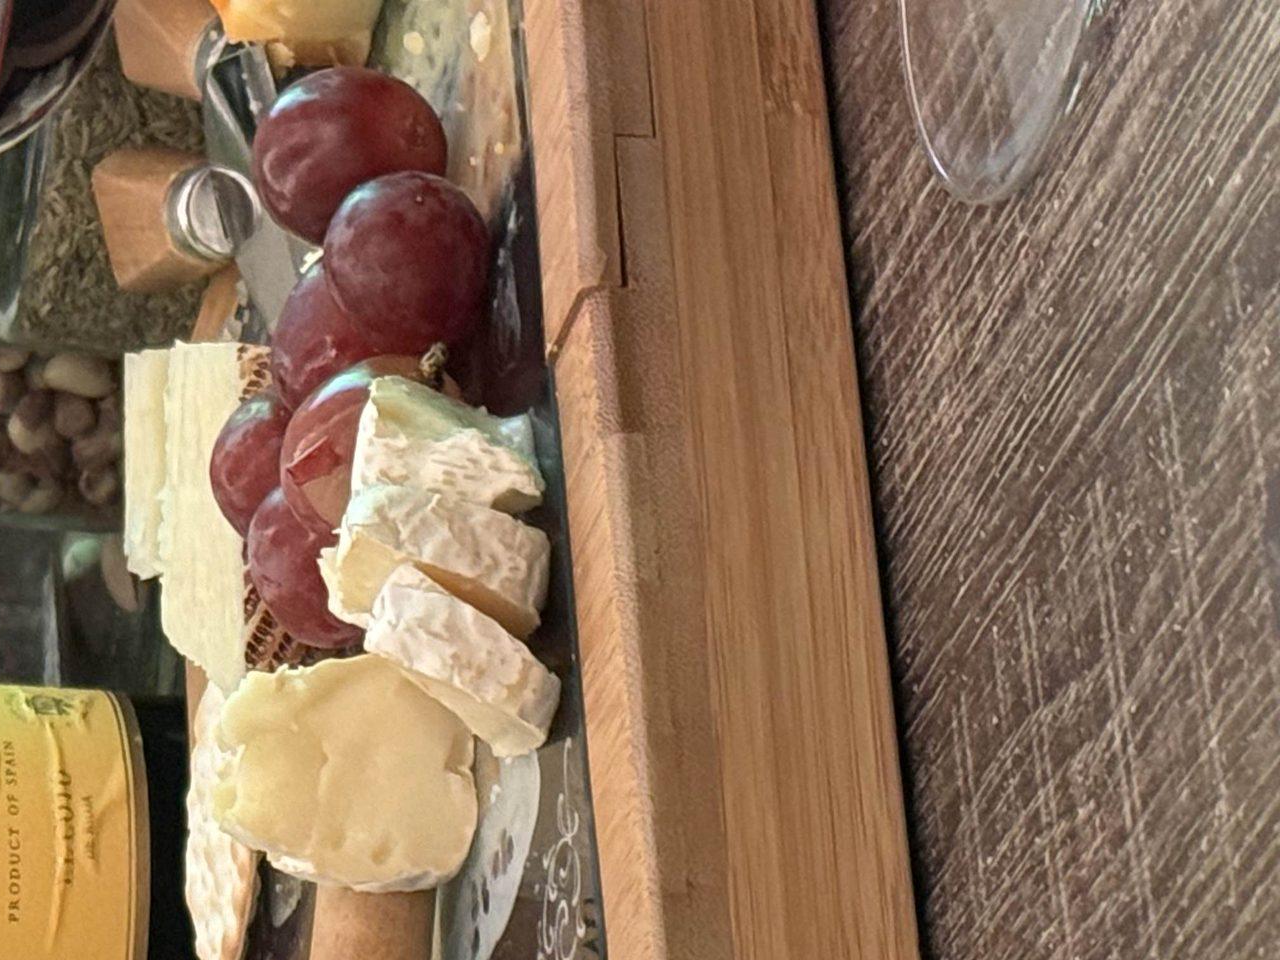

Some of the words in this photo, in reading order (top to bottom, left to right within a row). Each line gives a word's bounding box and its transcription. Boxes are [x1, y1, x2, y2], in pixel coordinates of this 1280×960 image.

[3, 740, 18, 785] SPAIN
[6, 795, 20, 817] OF
[7, 828, 21, 923] PRODUCT
